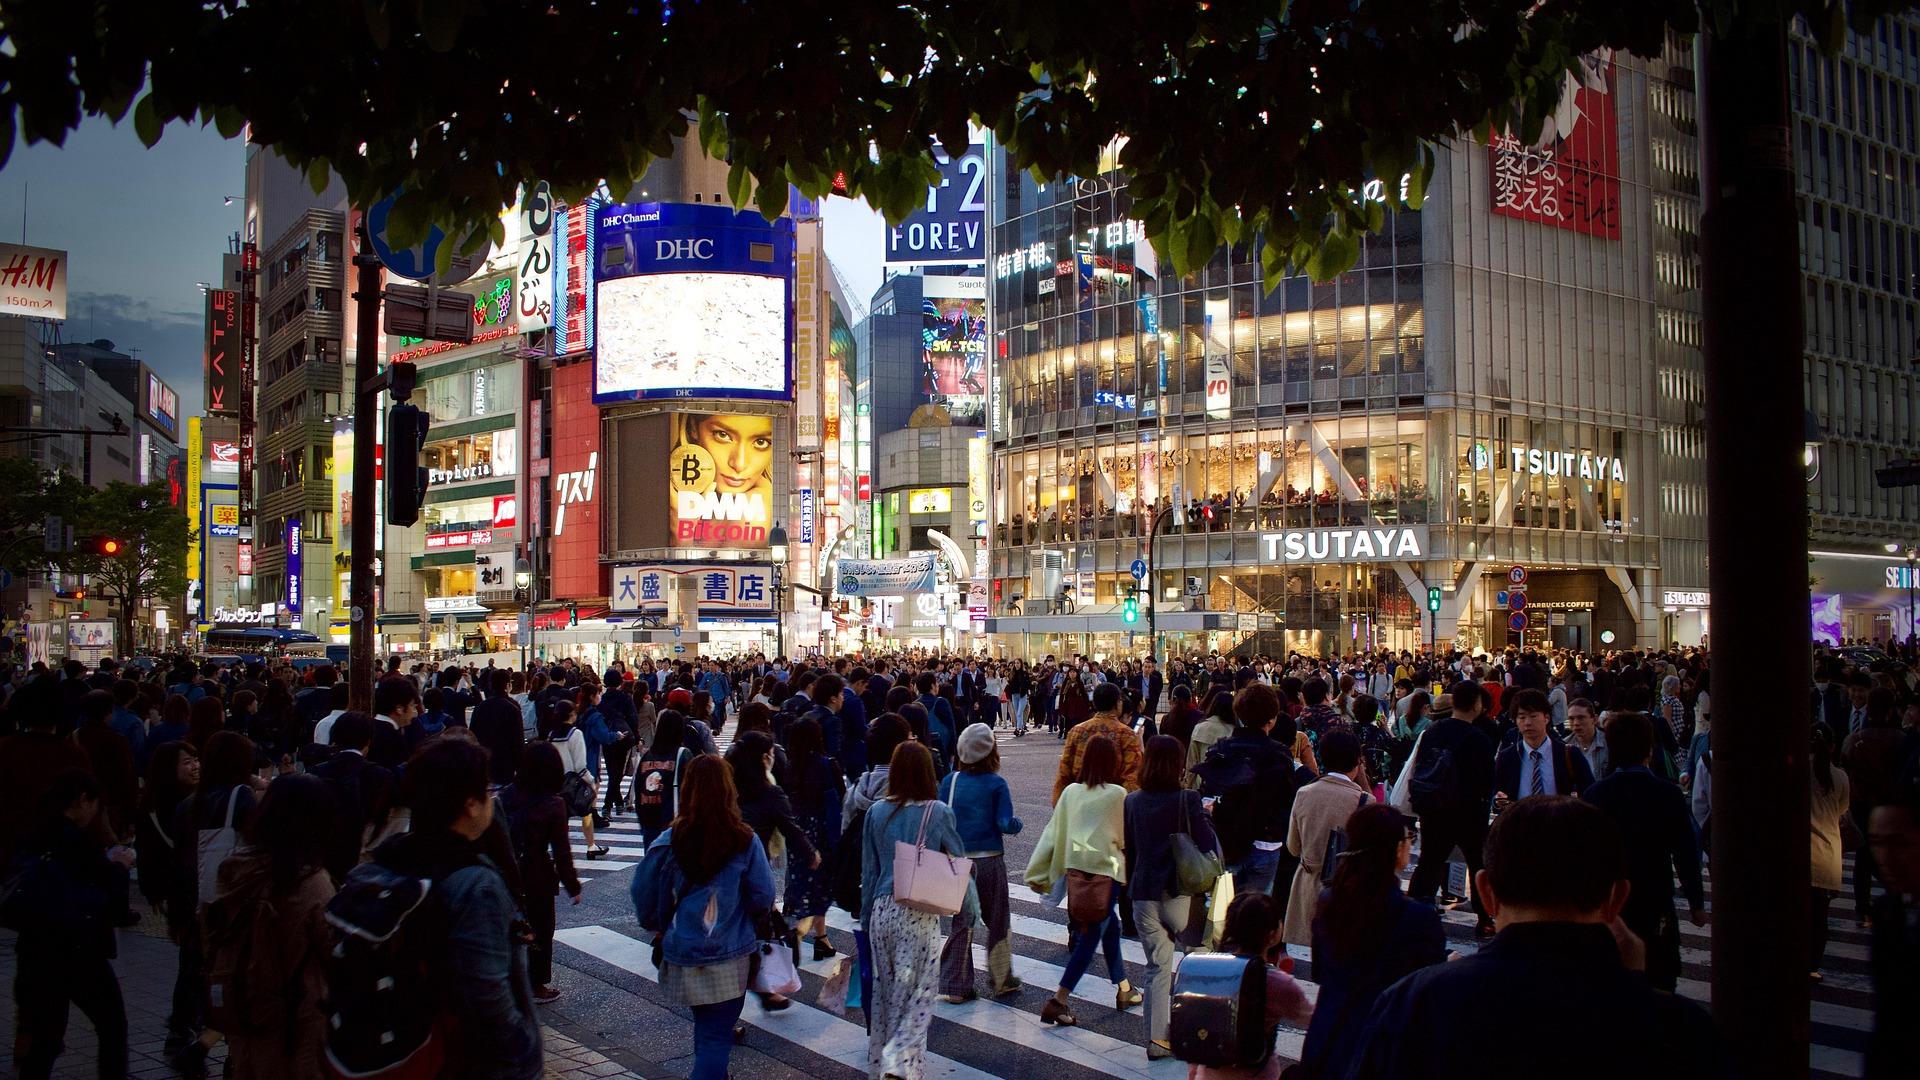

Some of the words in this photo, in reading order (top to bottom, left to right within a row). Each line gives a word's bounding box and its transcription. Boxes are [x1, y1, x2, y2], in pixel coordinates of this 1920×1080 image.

[603, 216, 621, 228] DHC
[622, 211, 660, 224] Channel
[656, 238, 714, 260] DHC
[1, 254, 58, 292] H&M
[6, 296, 40, 308] 150m
[226, 292, 234, 328] TOKYO
[476, 376, 484, 414] CAMERA
[428, 462, 490, 484] Euphoria
[1512, 447, 1625, 482] TSUTAYA
[218, 506, 237, 523] 薬
[678, 490, 766, 521] DMM
[677, 520, 766, 542] Bitcoin
[1262, 528, 1421, 560] TSUTAYA
[619, 573, 764, 600] 大盛書店
[1664, 592, 1706, 604] TSUTAYA
[214, 606, 262, 623] グルメタウン
